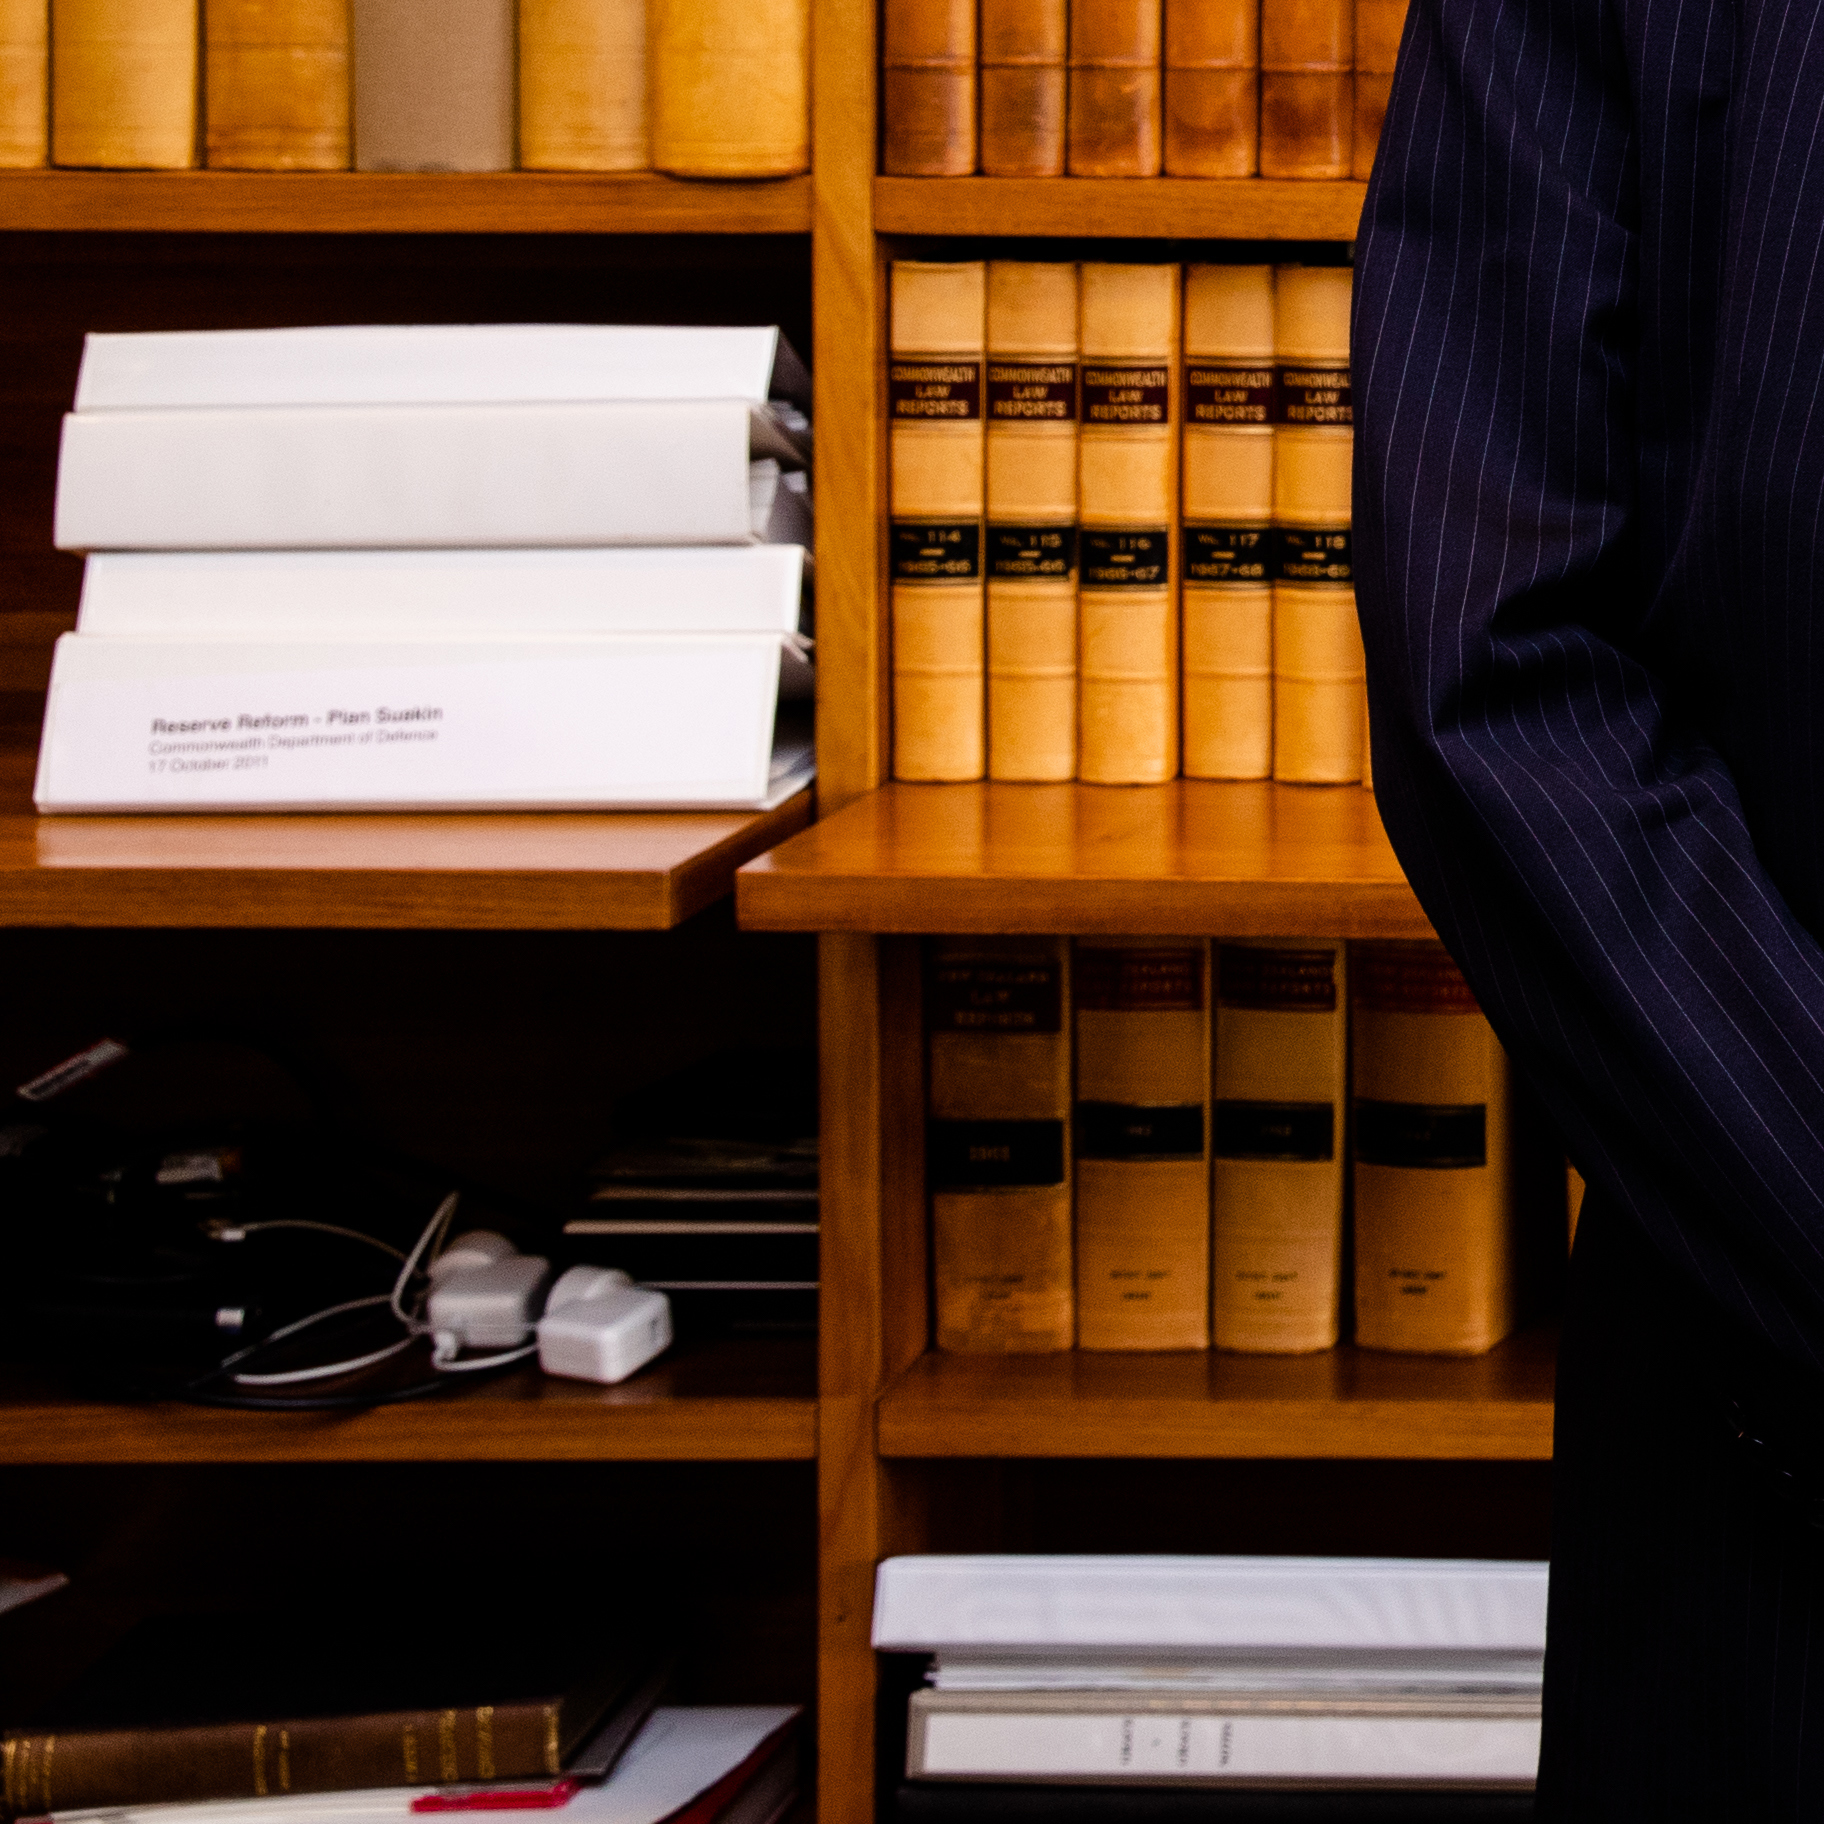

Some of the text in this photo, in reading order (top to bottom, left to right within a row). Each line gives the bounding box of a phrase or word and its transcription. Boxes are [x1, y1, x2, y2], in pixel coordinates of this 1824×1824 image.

[916, 385, 952, 400] LAW
[1109, 390, 1143, 403] LAW
[1214, 390, 1248, 404] LAW
[896, 400, 969, 416] REPORTS
[1091, 405, 1162, 421] REPORTS
[1196, 405, 1266, 421] REPORTS
[151, 717, 231, 734] Reserve
[237, 713, 309, 729] Reform
[326, 709, 371, 725] Plan
[376, 706, 443, 723] Suakin
[149, 730, 438, 755] Commonwealth Department of Defence
[170, 757, 229, 771] October
